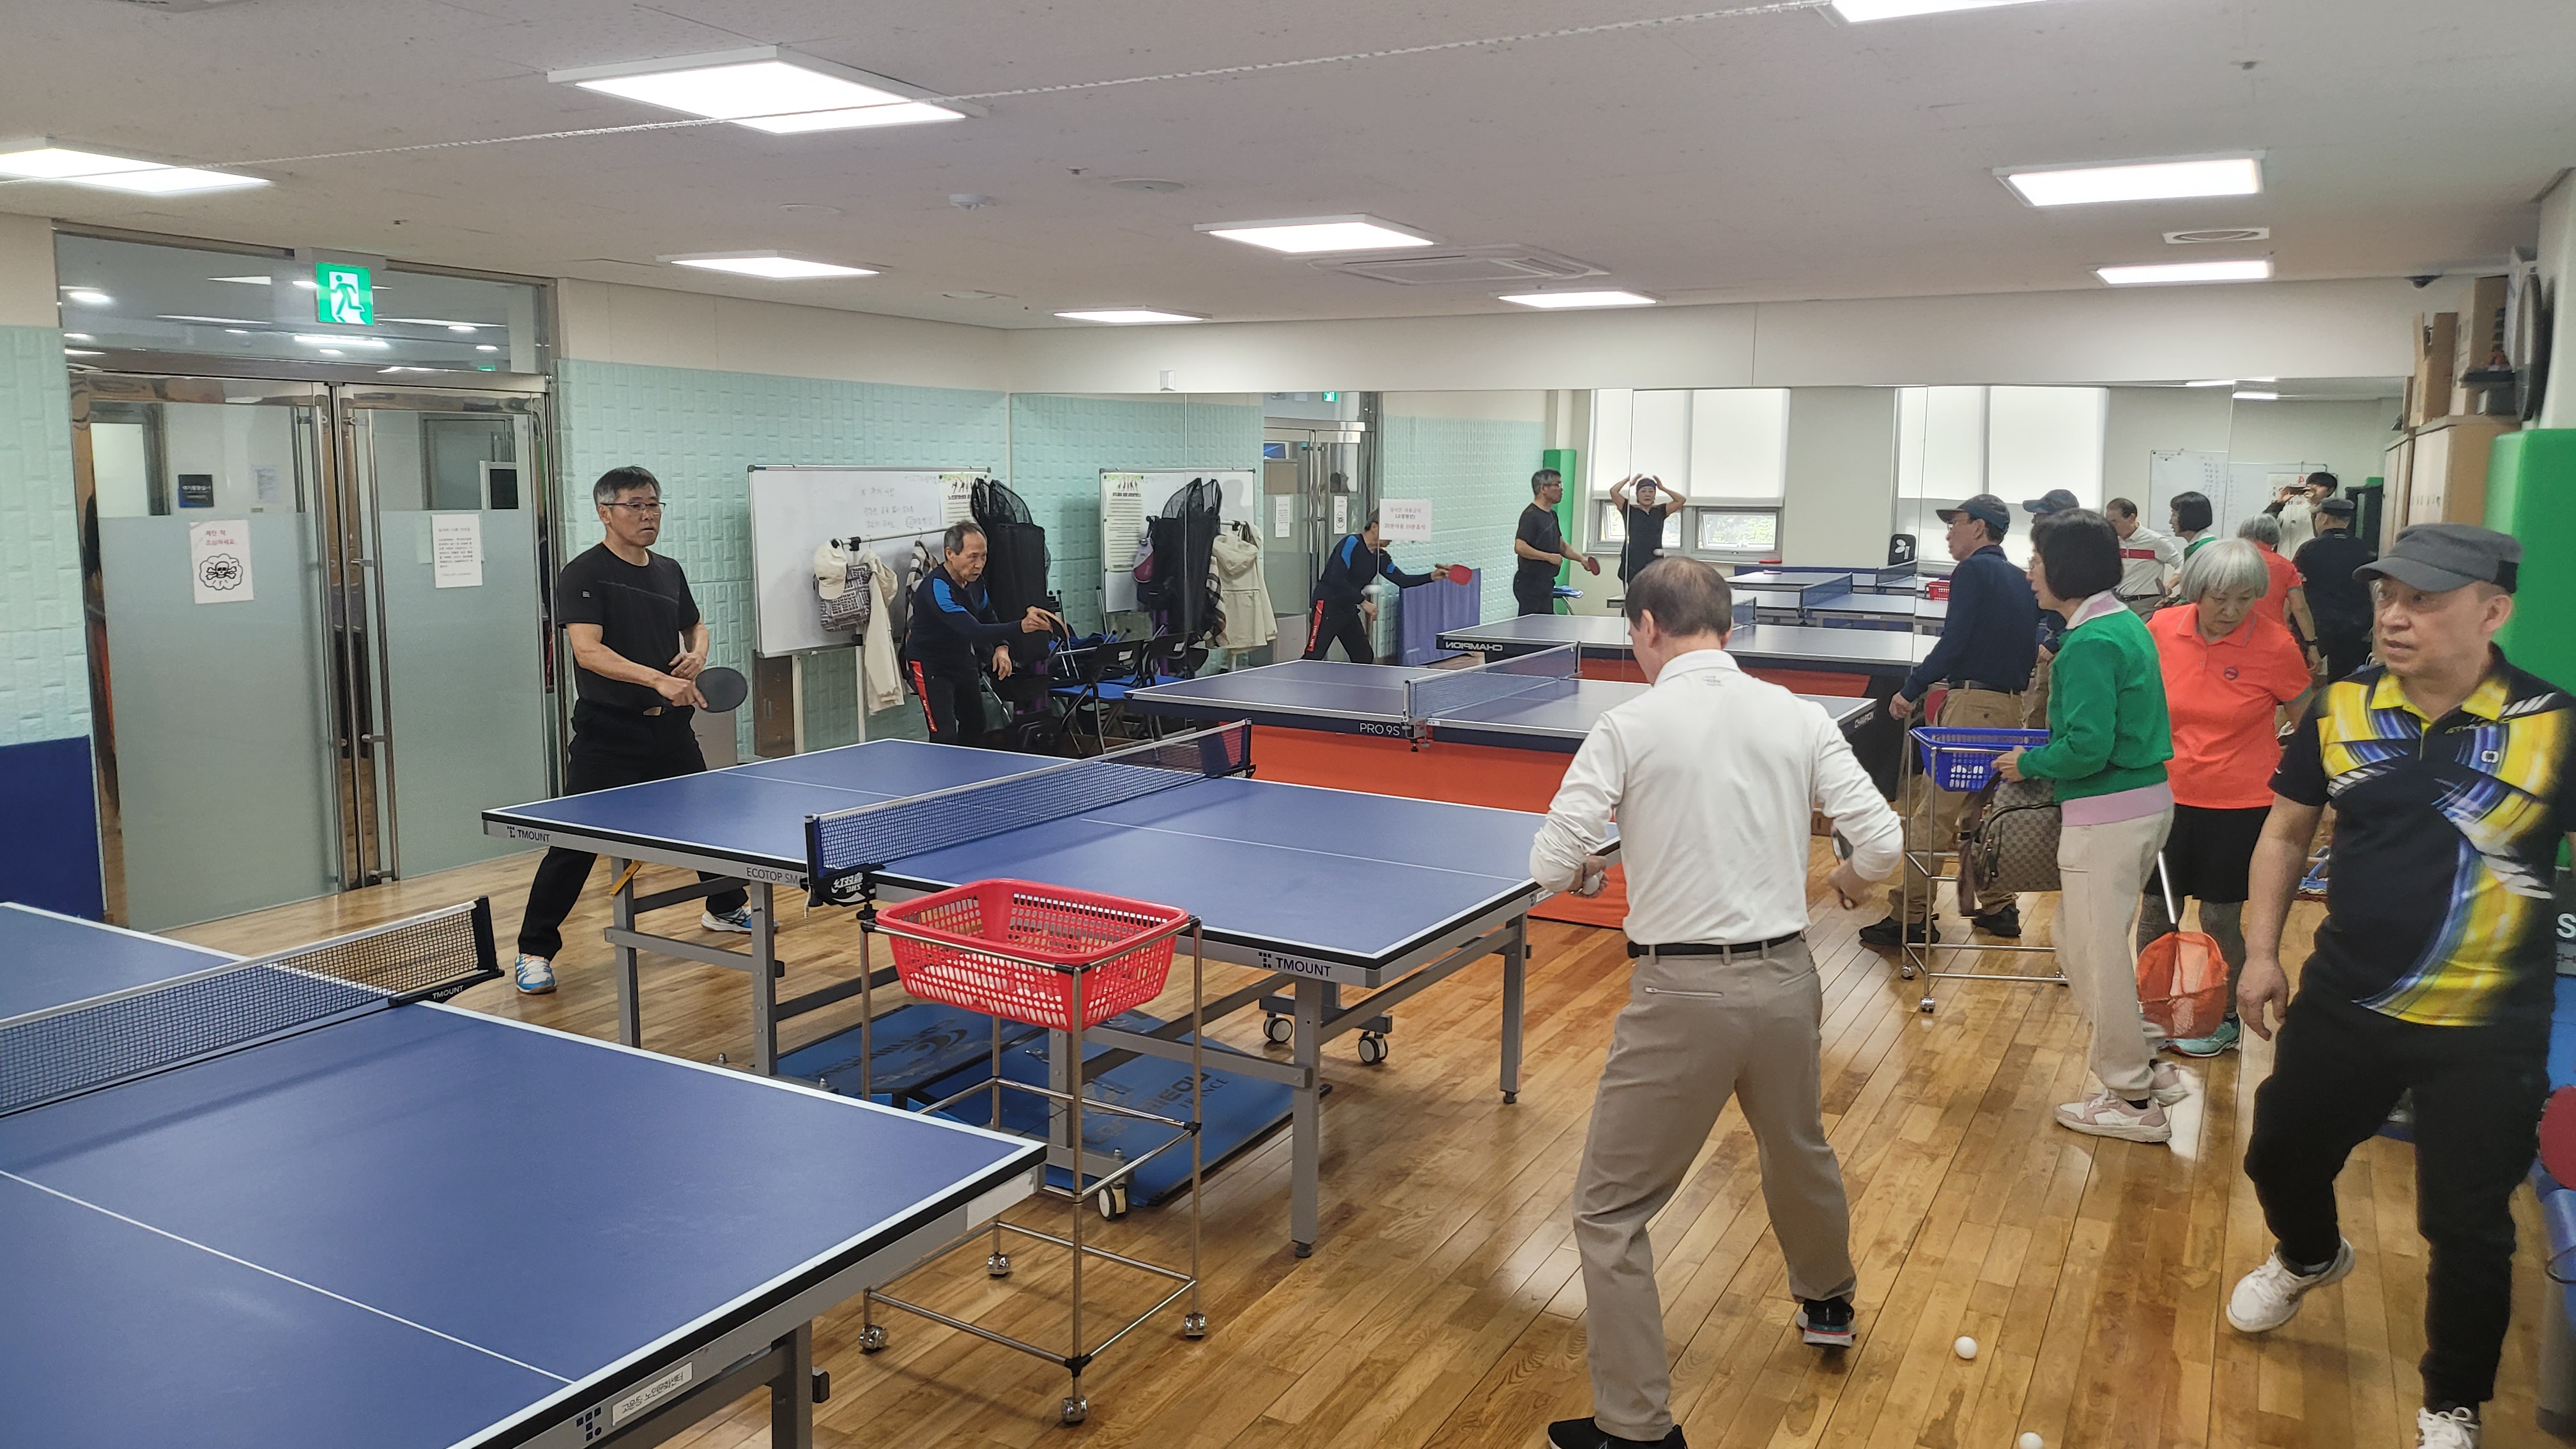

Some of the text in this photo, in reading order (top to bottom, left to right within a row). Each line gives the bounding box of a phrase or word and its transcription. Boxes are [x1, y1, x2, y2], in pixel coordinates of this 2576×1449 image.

[1360, 723, 1384, 735] PRO
[1386, 724, 1400, 736] 9S
[517, 829, 551, 843] TMOUNT
[746, 867, 783, 882] ECOTOP
[1275, 958, 1331, 977] TMOUNT
[432, 985, 464, 1000] TMOUNT
[644, 1371, 684, 1402] 노인문화센터
